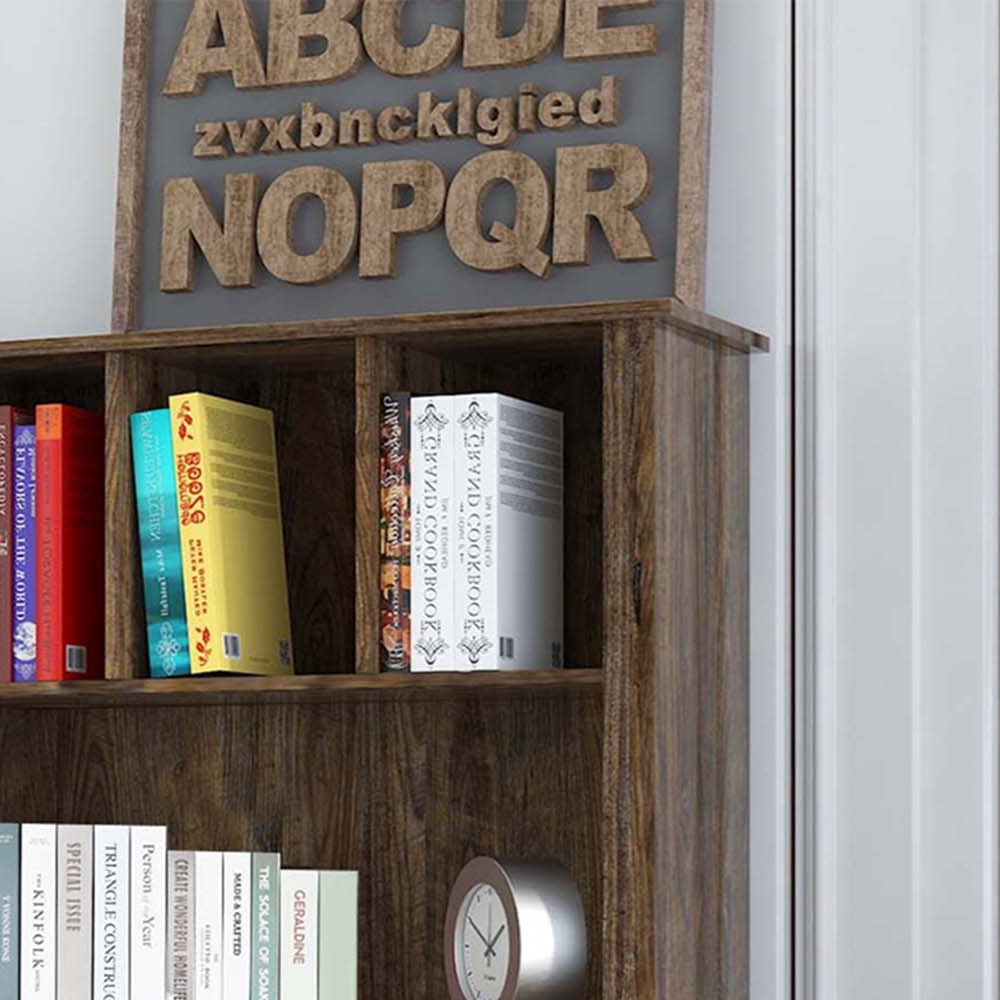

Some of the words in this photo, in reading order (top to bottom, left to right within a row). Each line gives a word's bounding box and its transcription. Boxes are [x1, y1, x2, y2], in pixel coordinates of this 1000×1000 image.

[192, 74, 622, 159] zvxbncklgied
[160, 142, 659, 293] NOPQR
[66, 842, 81, 893] SPECIAL
[103, 843, 117, 920] TRIANGLE
[142, 843, 155, 893] Person
[174, 859, 188, 892] CREATE
[233, 873, 242, 901] MADE
[258, 865, 269, 890] THE
[32, 889, 45, 969] KINFOLK
[65, 898, 81, 933] ISSUE
[173, 895, 188, 953] WONDERFUL
[233, 902, 242, 910] &
[258, 894, 270, 943] SOLACE
[293, 889, 306, 965] GERALDINE
[142, 916, 155, 948] Year
[233, 911, 242, 956] CRAFTED
[258, 946, 269, 962] OF
[173, 955, 187, 1000] HOMELIFE
